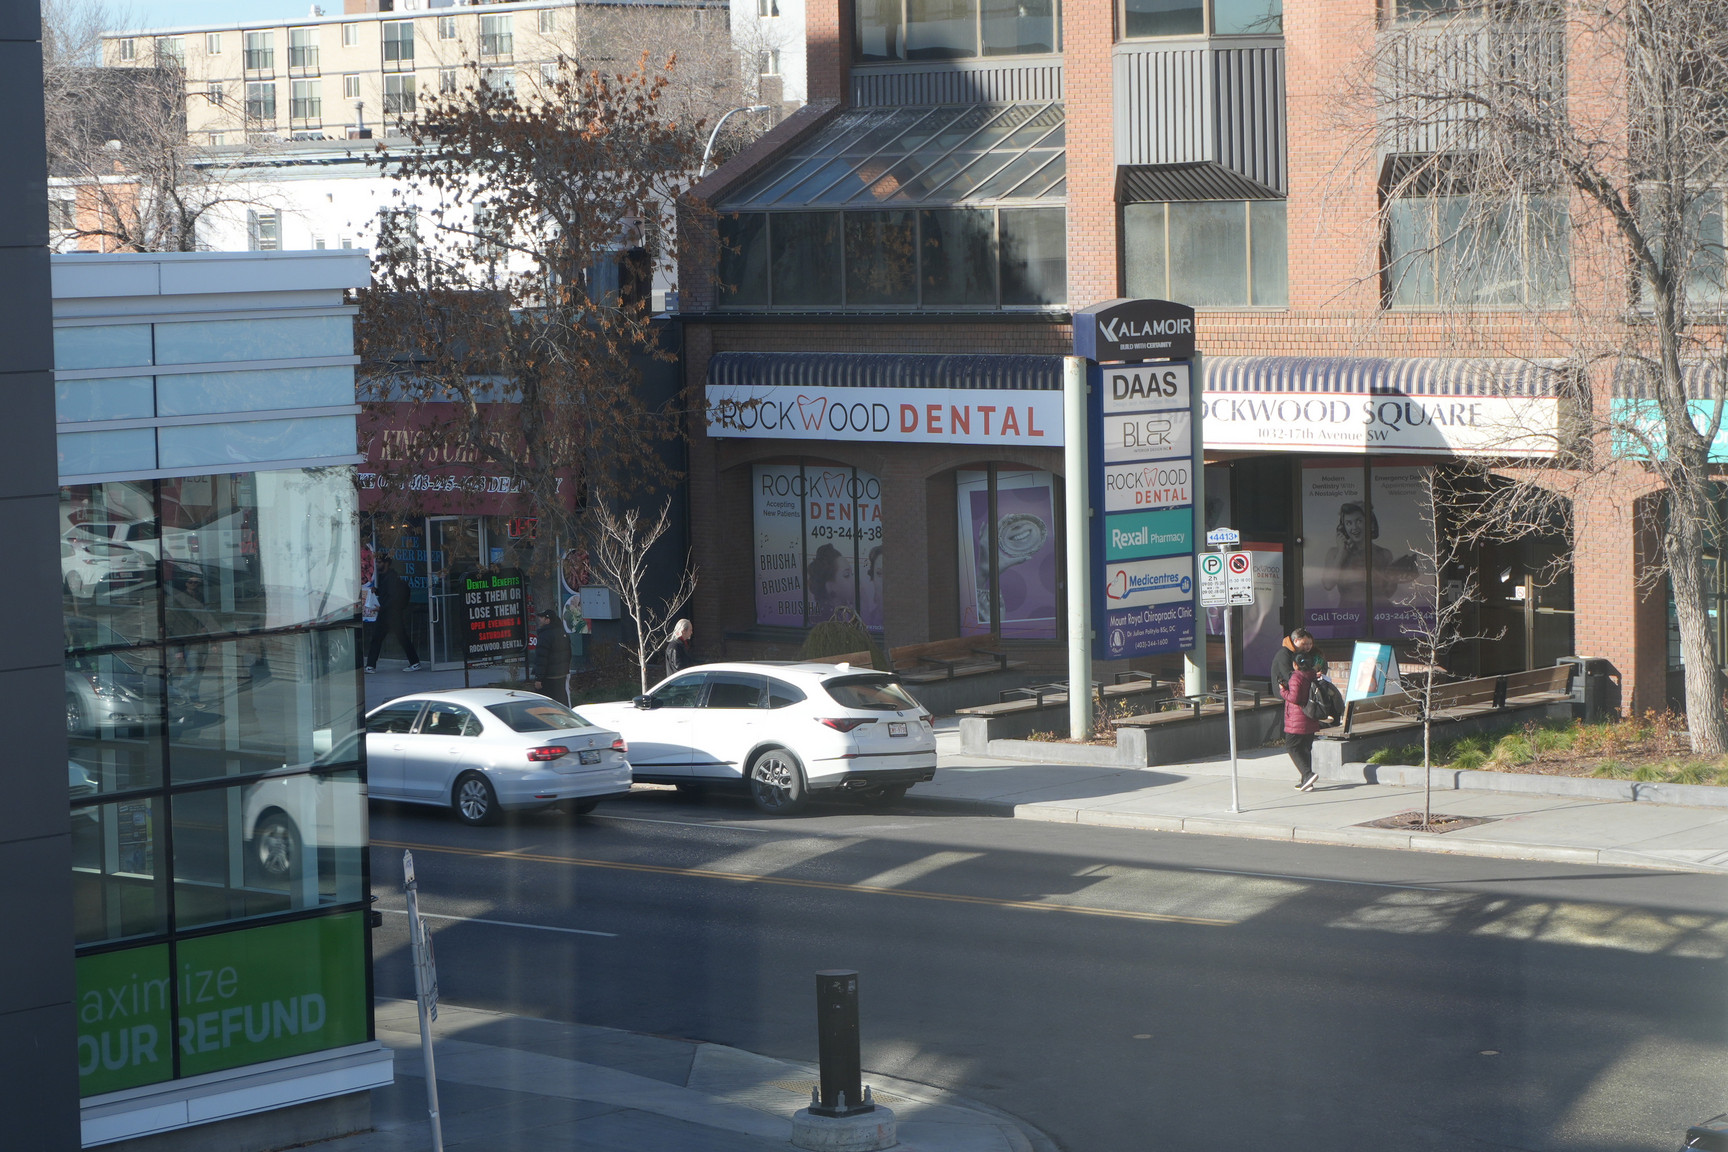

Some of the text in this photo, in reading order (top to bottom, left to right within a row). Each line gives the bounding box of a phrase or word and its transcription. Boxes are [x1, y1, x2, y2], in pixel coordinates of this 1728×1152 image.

[1100, 317, 1192, 342] KALAMOIR
[1113, 372, 1177, 400] DAAS
[722, 394, 1044, 436] ROCKWOOD DENTAL
[1362, 400, 1482, 432] SQUARE
[1258, 428, 1389, 442] 1032-17th Avenue SW
[1106, 468, 1187, 490] ROCKWOOD
[1312, 482, 1340, 490] Dentistry
[1136, 488, 1188, 504] DENTAL
[1314, 490, 1343, 498] Nostalgic
[766, 500, 795, 510] Accepting
[810, 502, 882, 522] DENTA
[776, 510, 800, 518] Patients
[1112, 526, 1184, 549] Rexall Pharmacy
[1214, 532, 1234, 540] 4413
[405, 562, 415, 574] IS
[760, 553, 797, 570] BRUSHA
[1208, 560, 1218, 571] P
[762, 576, 800, 595] BRUSHA
[1130, 573, 1179, 587] Medicentres
[466, 588, 521, 605] USE THEM OR
[469, 603, 520, 620] LOSE THEM!
[778, 600, 820, 616] BRUSHA
[470, 621, 486, 630] OPEN
[488, 618, 514, 628] EVENINGS
[1110, 607, 1192, 627] Mount Royal Chiropractic Clinic
[1311, 612, 1360, 622] Call Today
[479, 630, 512, 640] SATURDAYS
[170, 993, 326, 1060] REFUND
